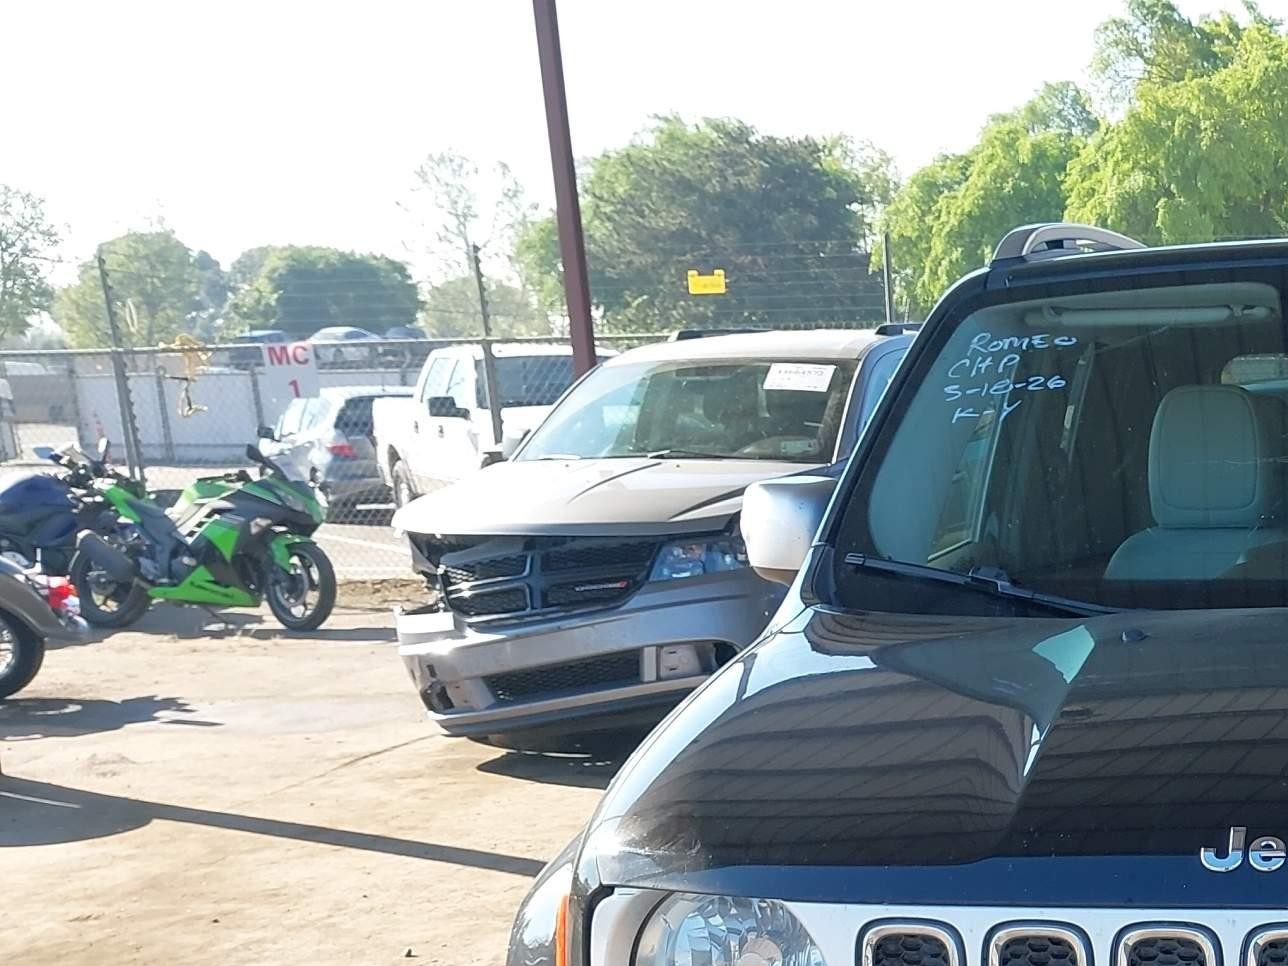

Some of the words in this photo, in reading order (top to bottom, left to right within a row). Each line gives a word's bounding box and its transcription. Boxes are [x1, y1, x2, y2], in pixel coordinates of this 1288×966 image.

[966, 332, 1077, 356] ROMEO
[267, 345, 310, 366] MC
[288, 379, 301, 398] 1
